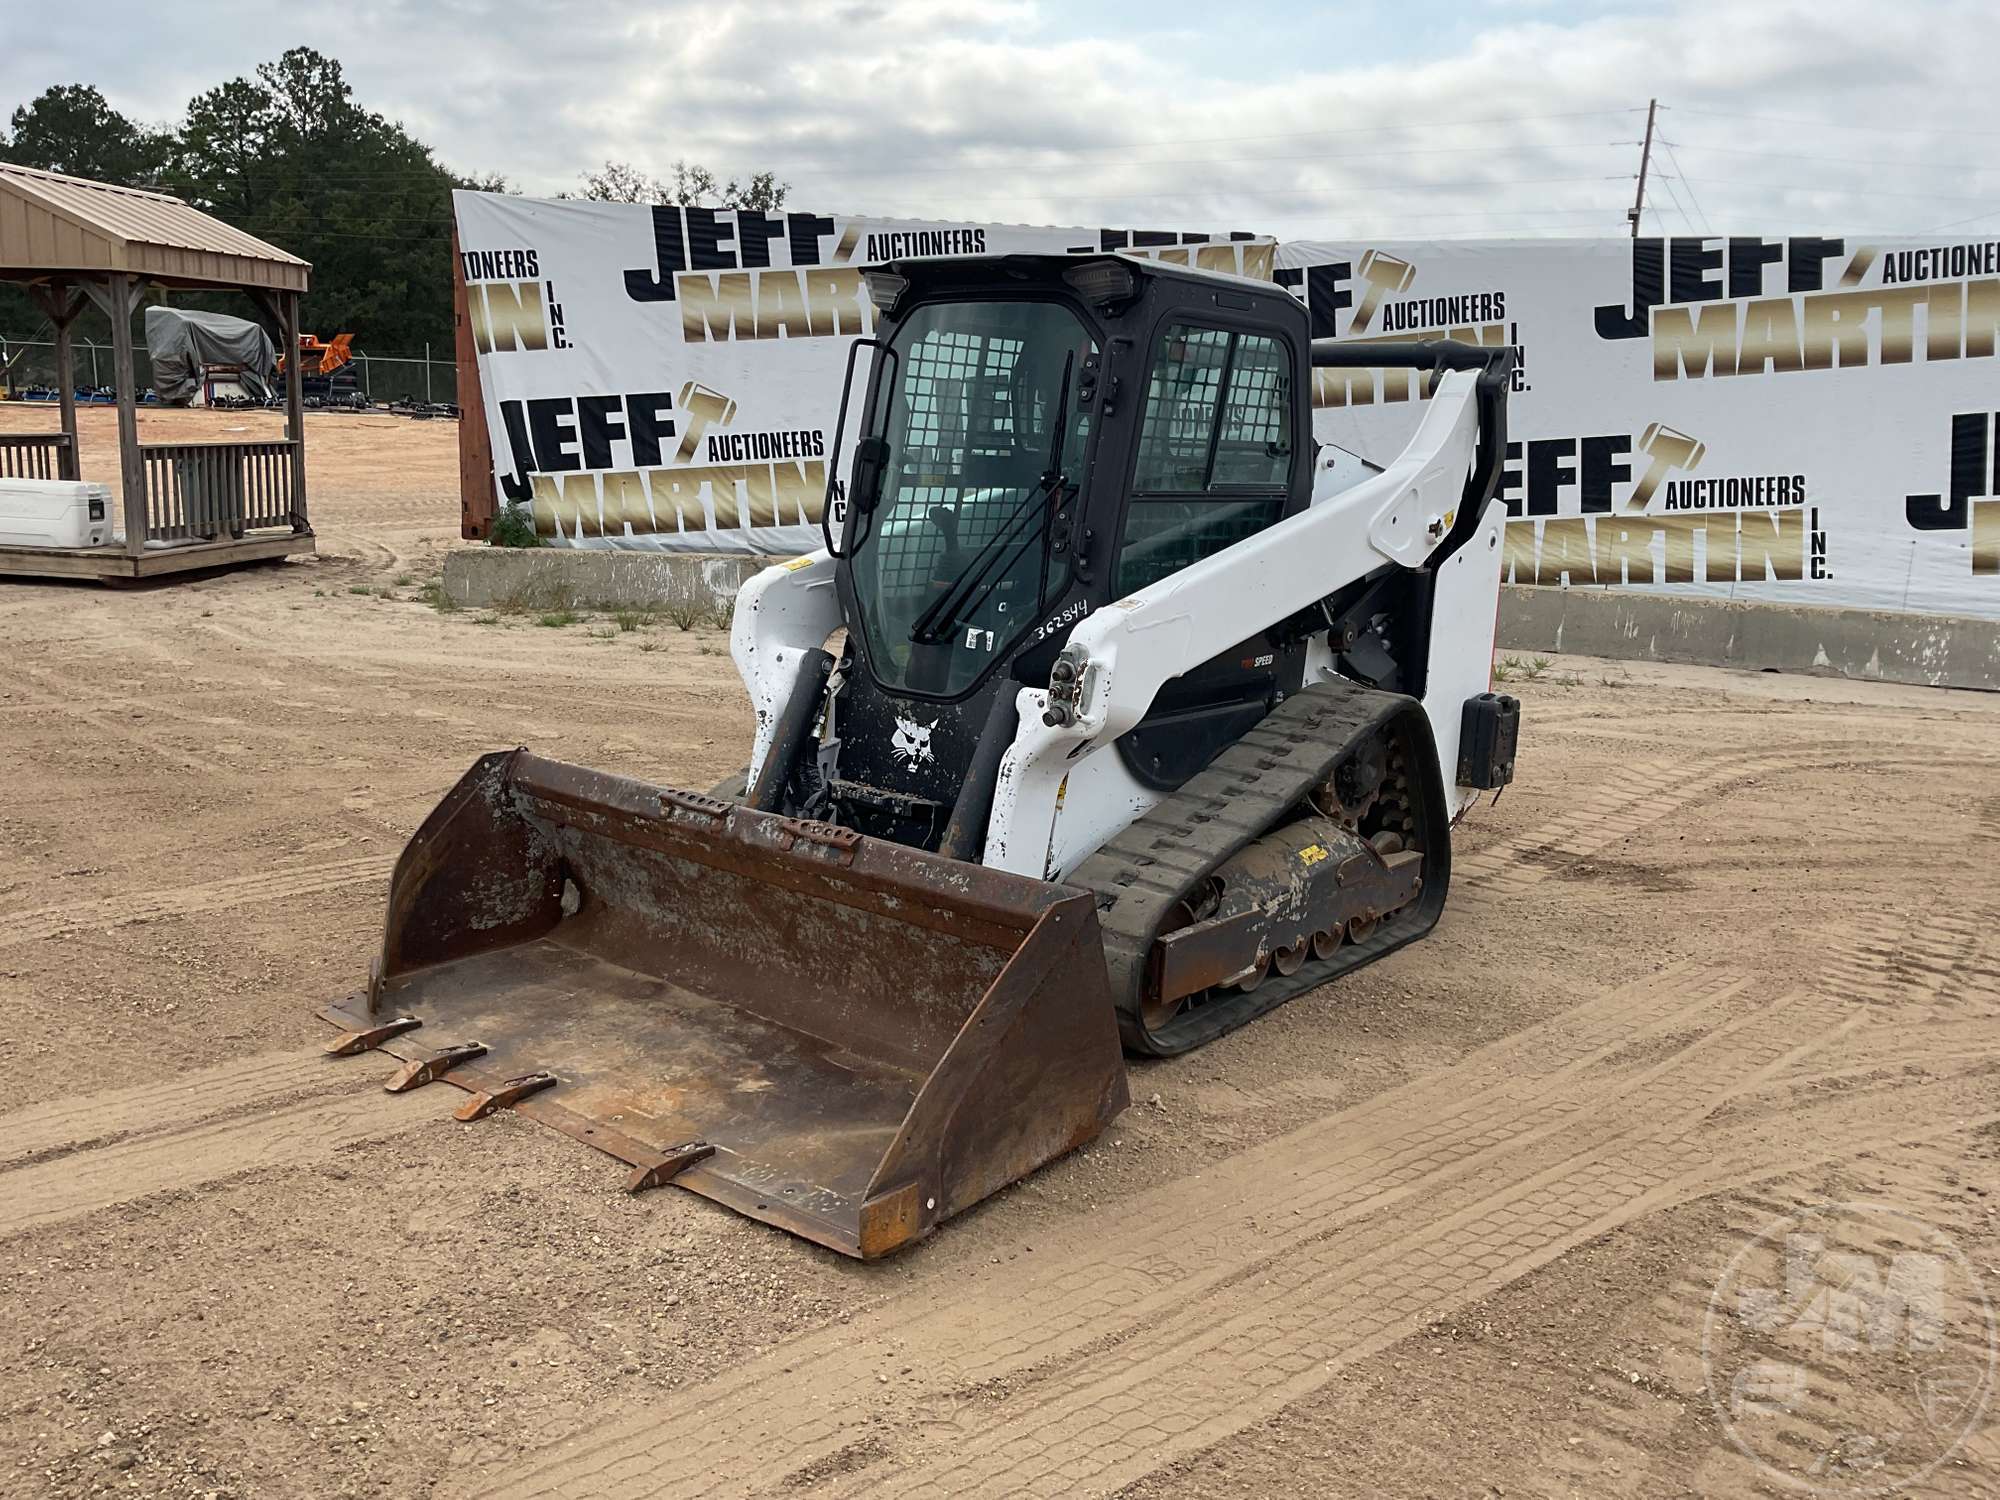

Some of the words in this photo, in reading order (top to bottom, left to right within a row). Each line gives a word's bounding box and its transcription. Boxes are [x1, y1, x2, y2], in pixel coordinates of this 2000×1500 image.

[624, 206, 836, 303] JEFF
[867, 228, 986, 263] AUCTIONEERS
[1882, 241, 2000, 285] AUCTIONE
[1594, 236, 1845, 341] JEFF
[1382, 292, 1506, 333] AUCTIONEERS
[499, 392, 676, 503] JEFF
[708, 430, 825, 463] AUCTIONEERS
[532, 460, 825, 539] MARTIN
[1664, 475, 1806, 511] AUCTIONEERS
[1033, 599, 1088, 640] 362844
